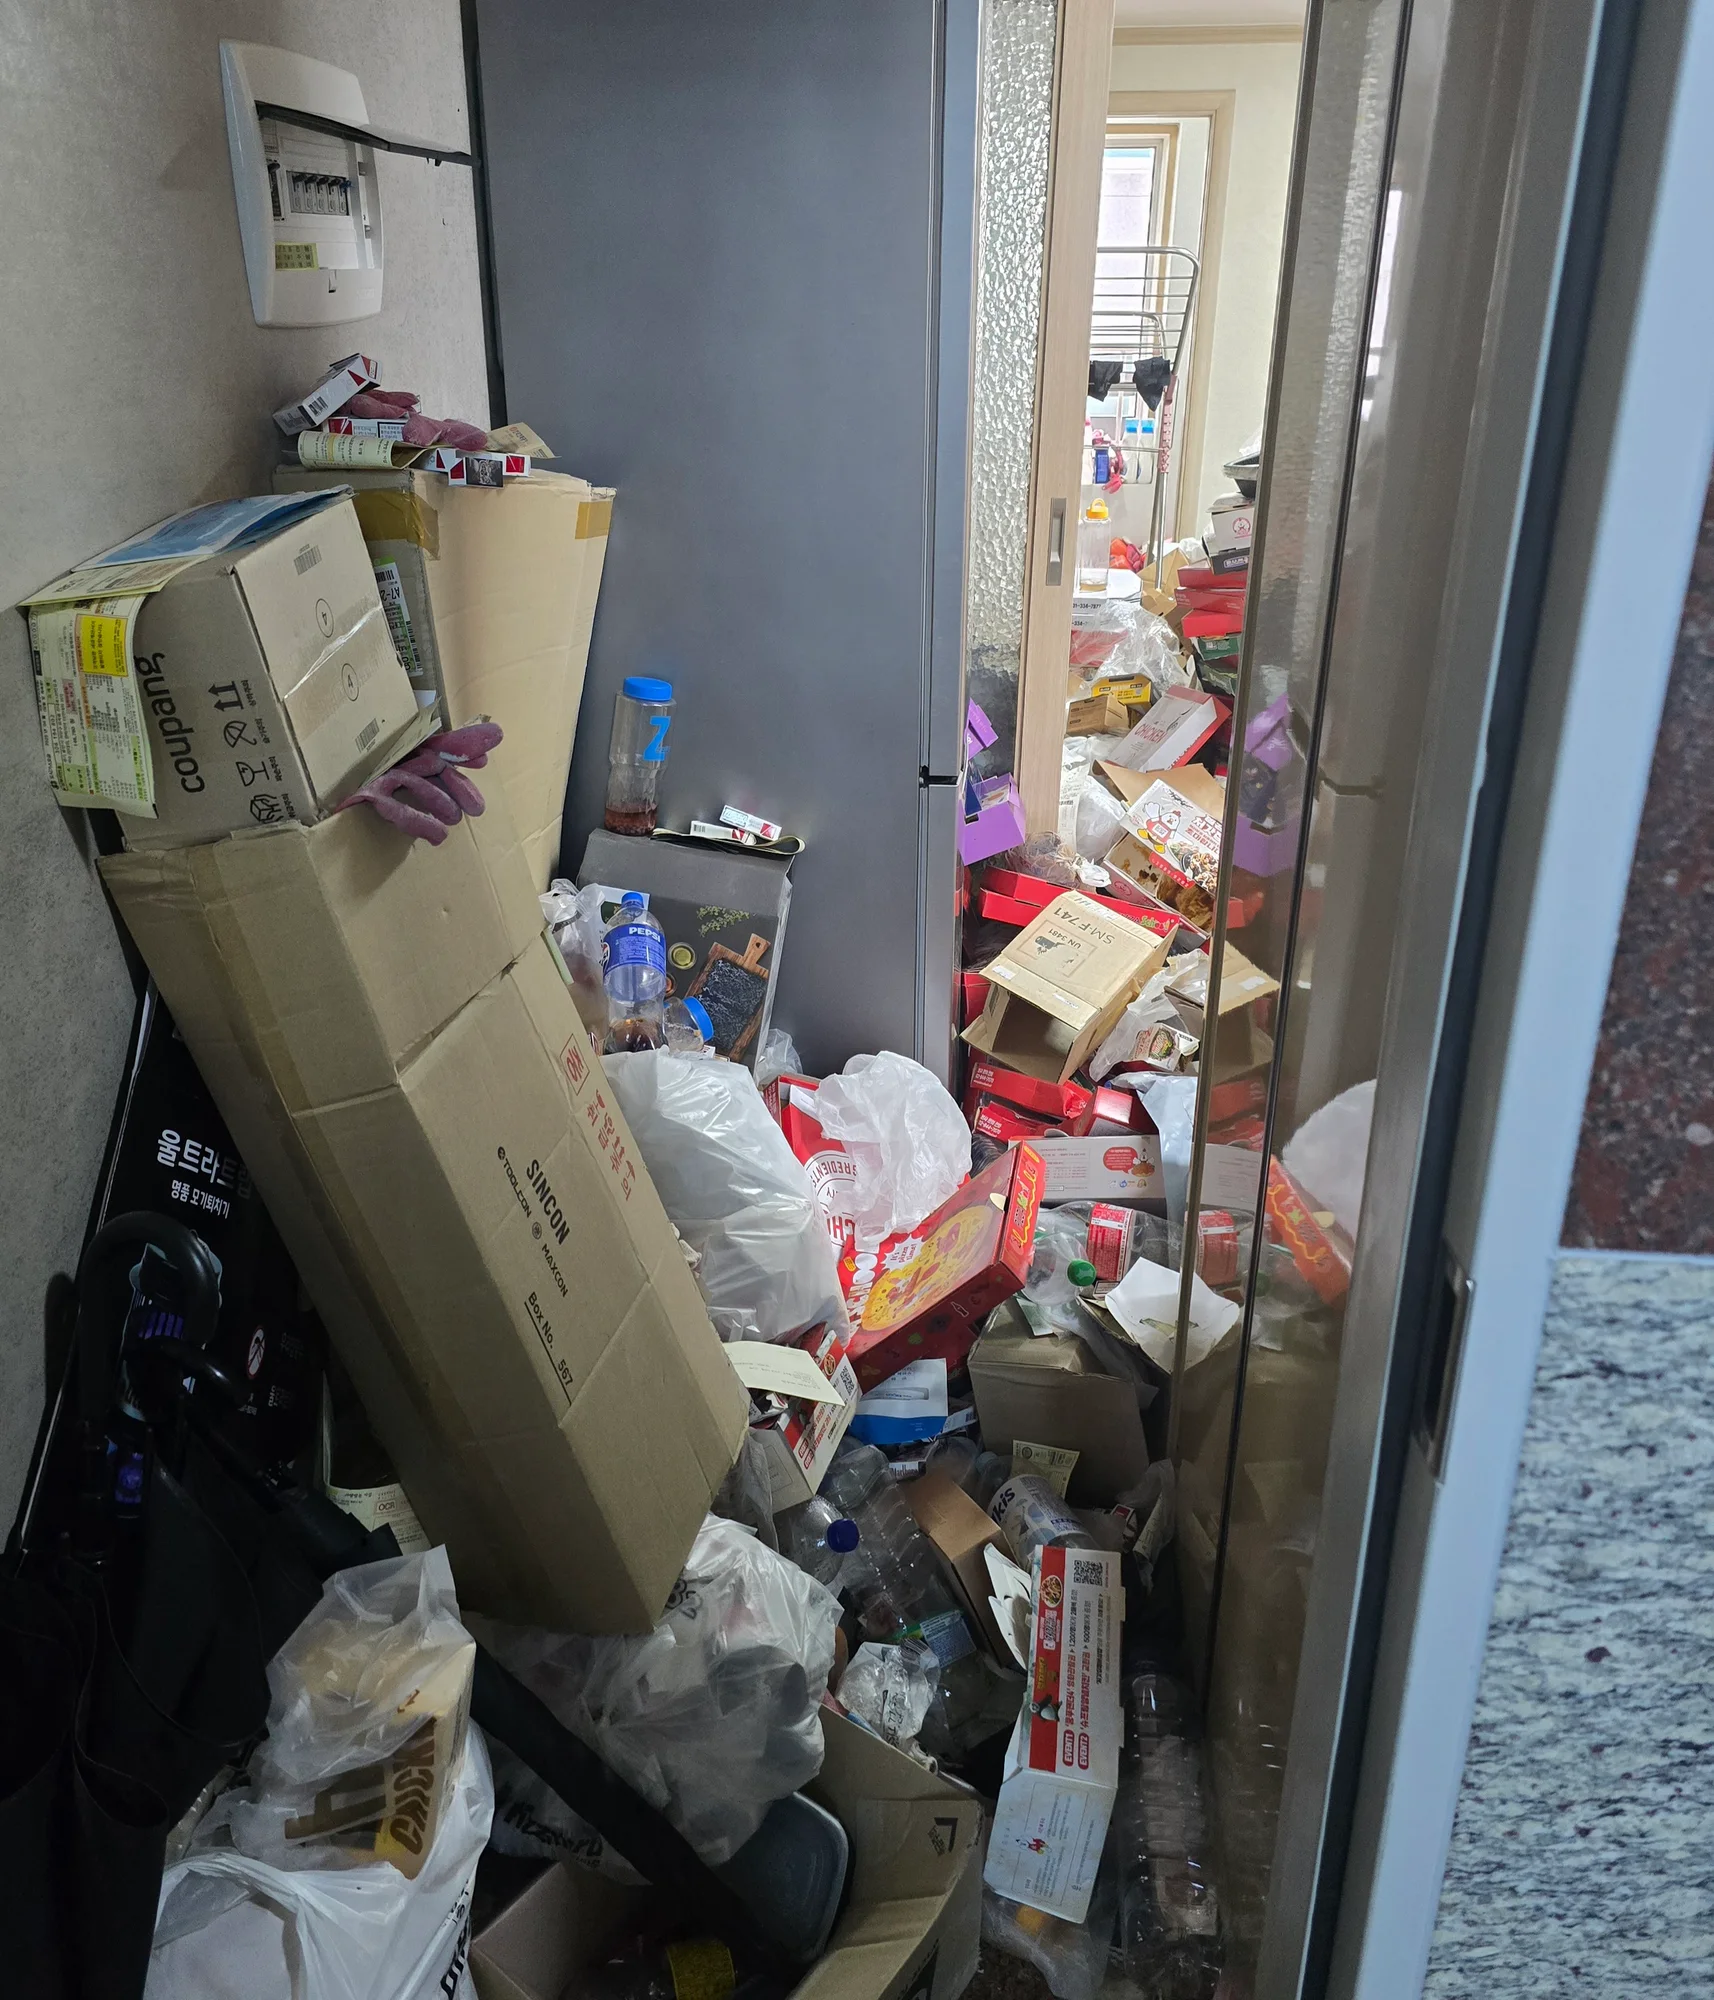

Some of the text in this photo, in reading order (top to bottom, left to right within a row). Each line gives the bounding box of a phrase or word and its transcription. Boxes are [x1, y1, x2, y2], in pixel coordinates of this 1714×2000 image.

[136, 651, 206, 794] coupang
[643, 716, 671, 761] Z
[1134, 723, 1167, 744] CHICKEN
[629, 925, 661, 943] PEPSI
[1048, 929, 1081, 948] UN 3481
[1054, 908, 1114, 943] SM-F741
[170, 1178, 231, 1219] 명품 모기퇴치기
[525, 1159, 571, 1245] SINCON
[501, 1158, 569, 1297] TOOLCON MAXCON
[890, 1243, 917, 1264] It's pizza time!
[527, 1291, 575, 1386] Box No. 567
[379, 1502, 396, 1511] OCR
